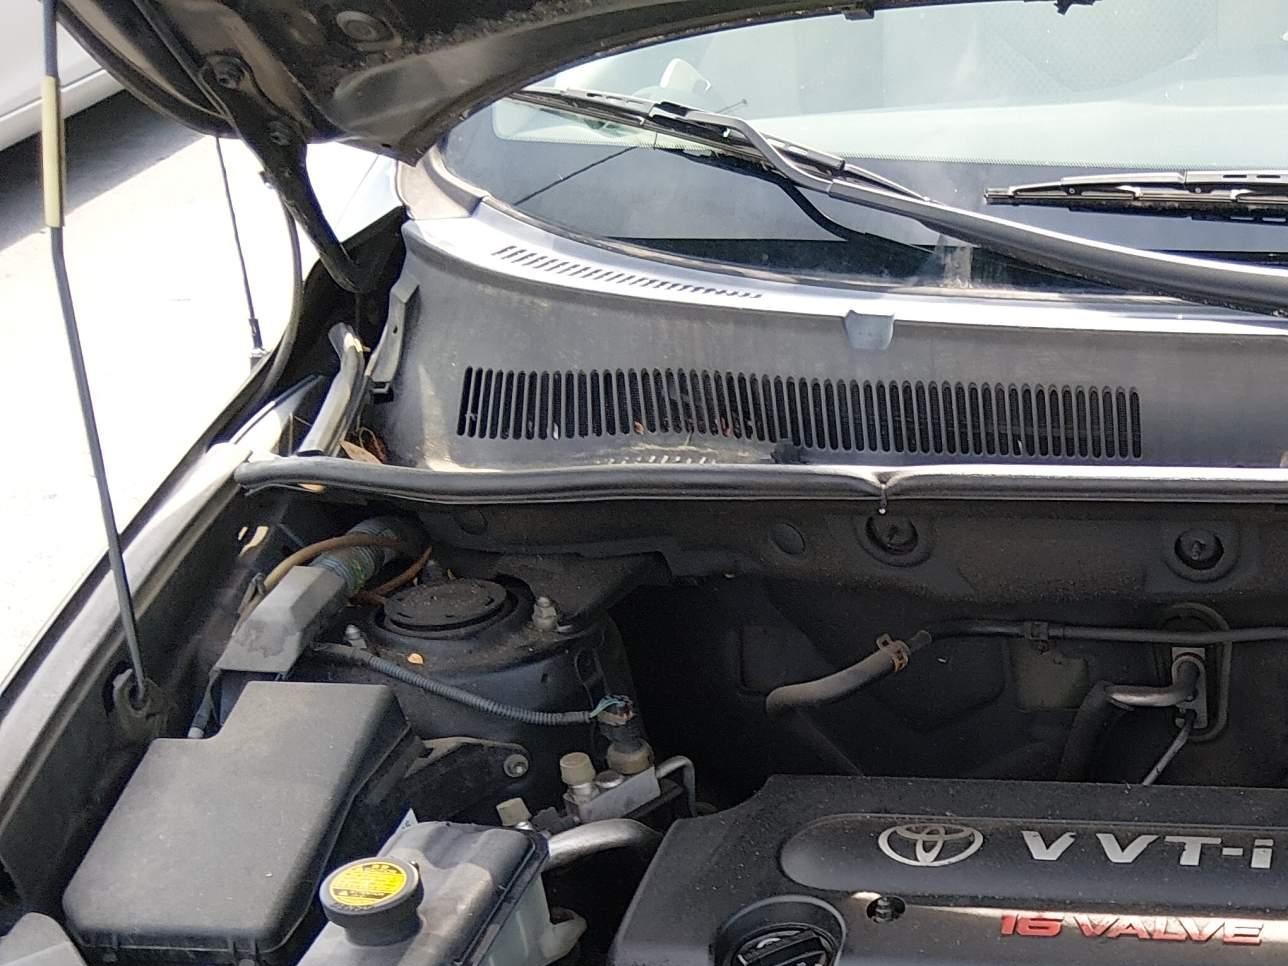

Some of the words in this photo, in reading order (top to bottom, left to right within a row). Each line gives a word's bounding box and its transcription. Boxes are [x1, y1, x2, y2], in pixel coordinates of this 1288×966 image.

[1020, 829, 1275, 869] VVT-i
[1000, 914, 1064, 937] 16
[1071, 915, 1265, 946] VALVE
